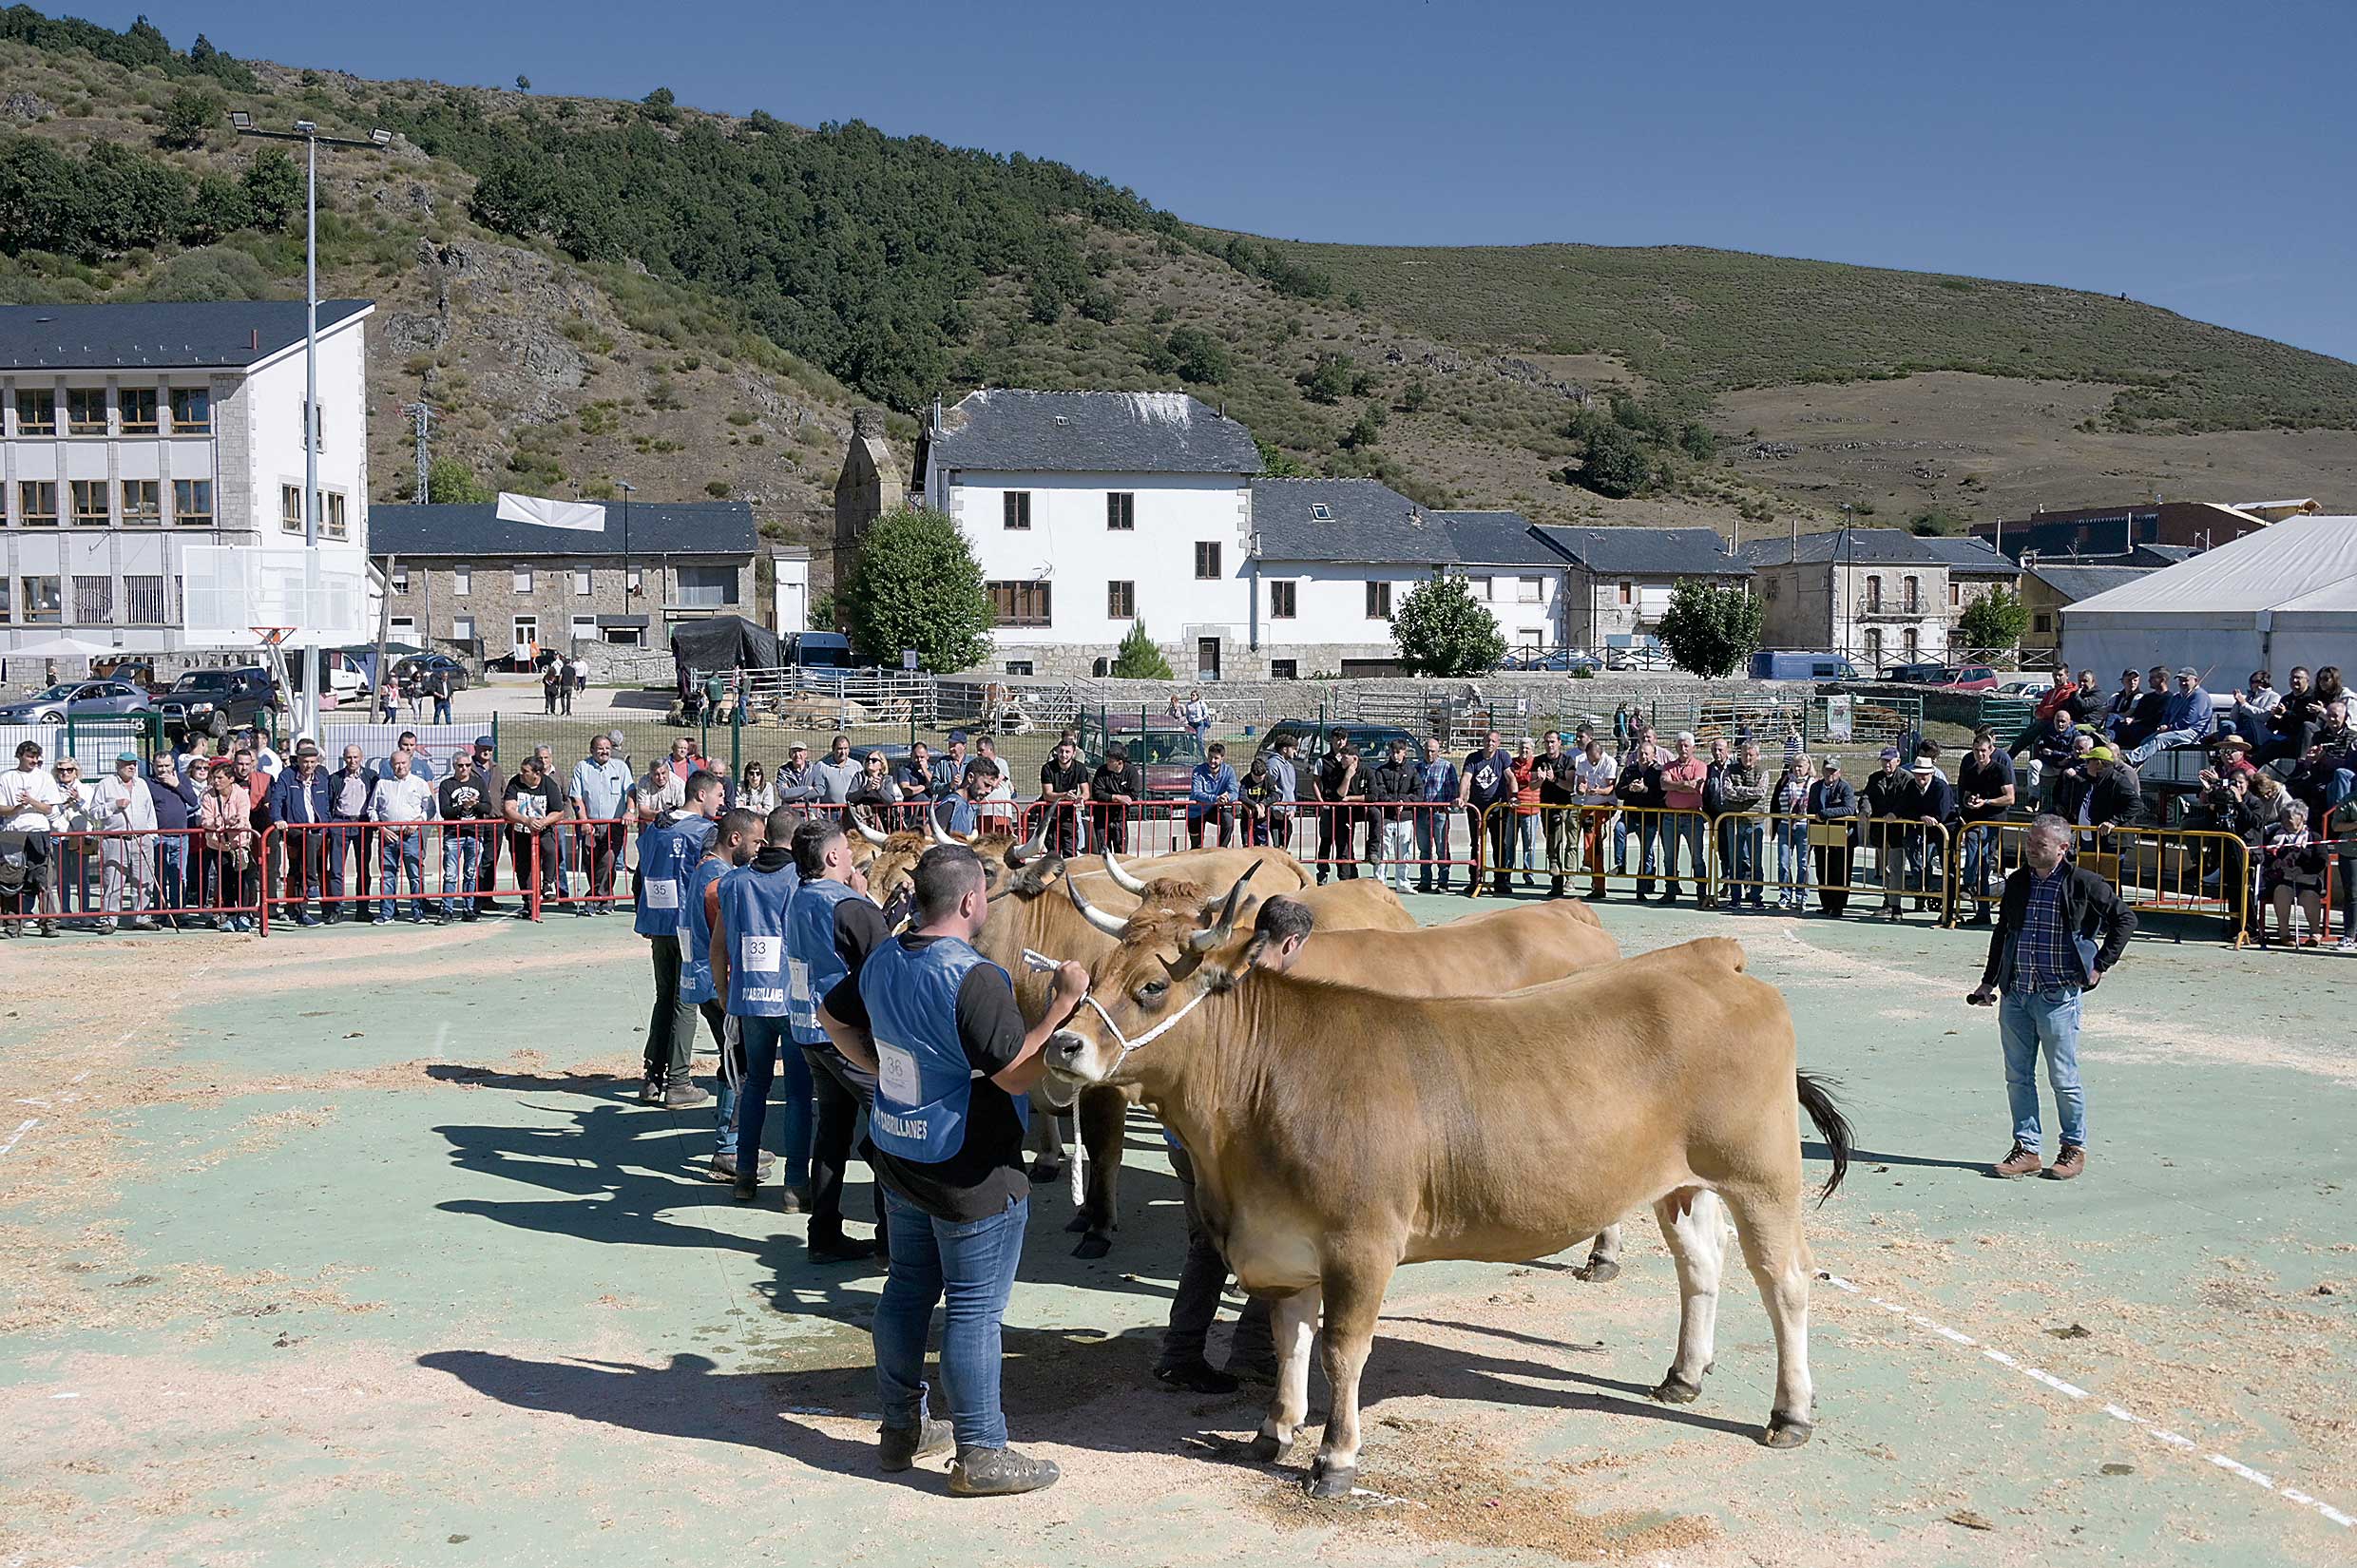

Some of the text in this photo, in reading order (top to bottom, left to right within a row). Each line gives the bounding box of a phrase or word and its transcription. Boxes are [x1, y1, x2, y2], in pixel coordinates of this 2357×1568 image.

[653, 885, 666, 895] 35
[750, 942, 766, 955] 33
[887, 1056, 904, 1077] 36
